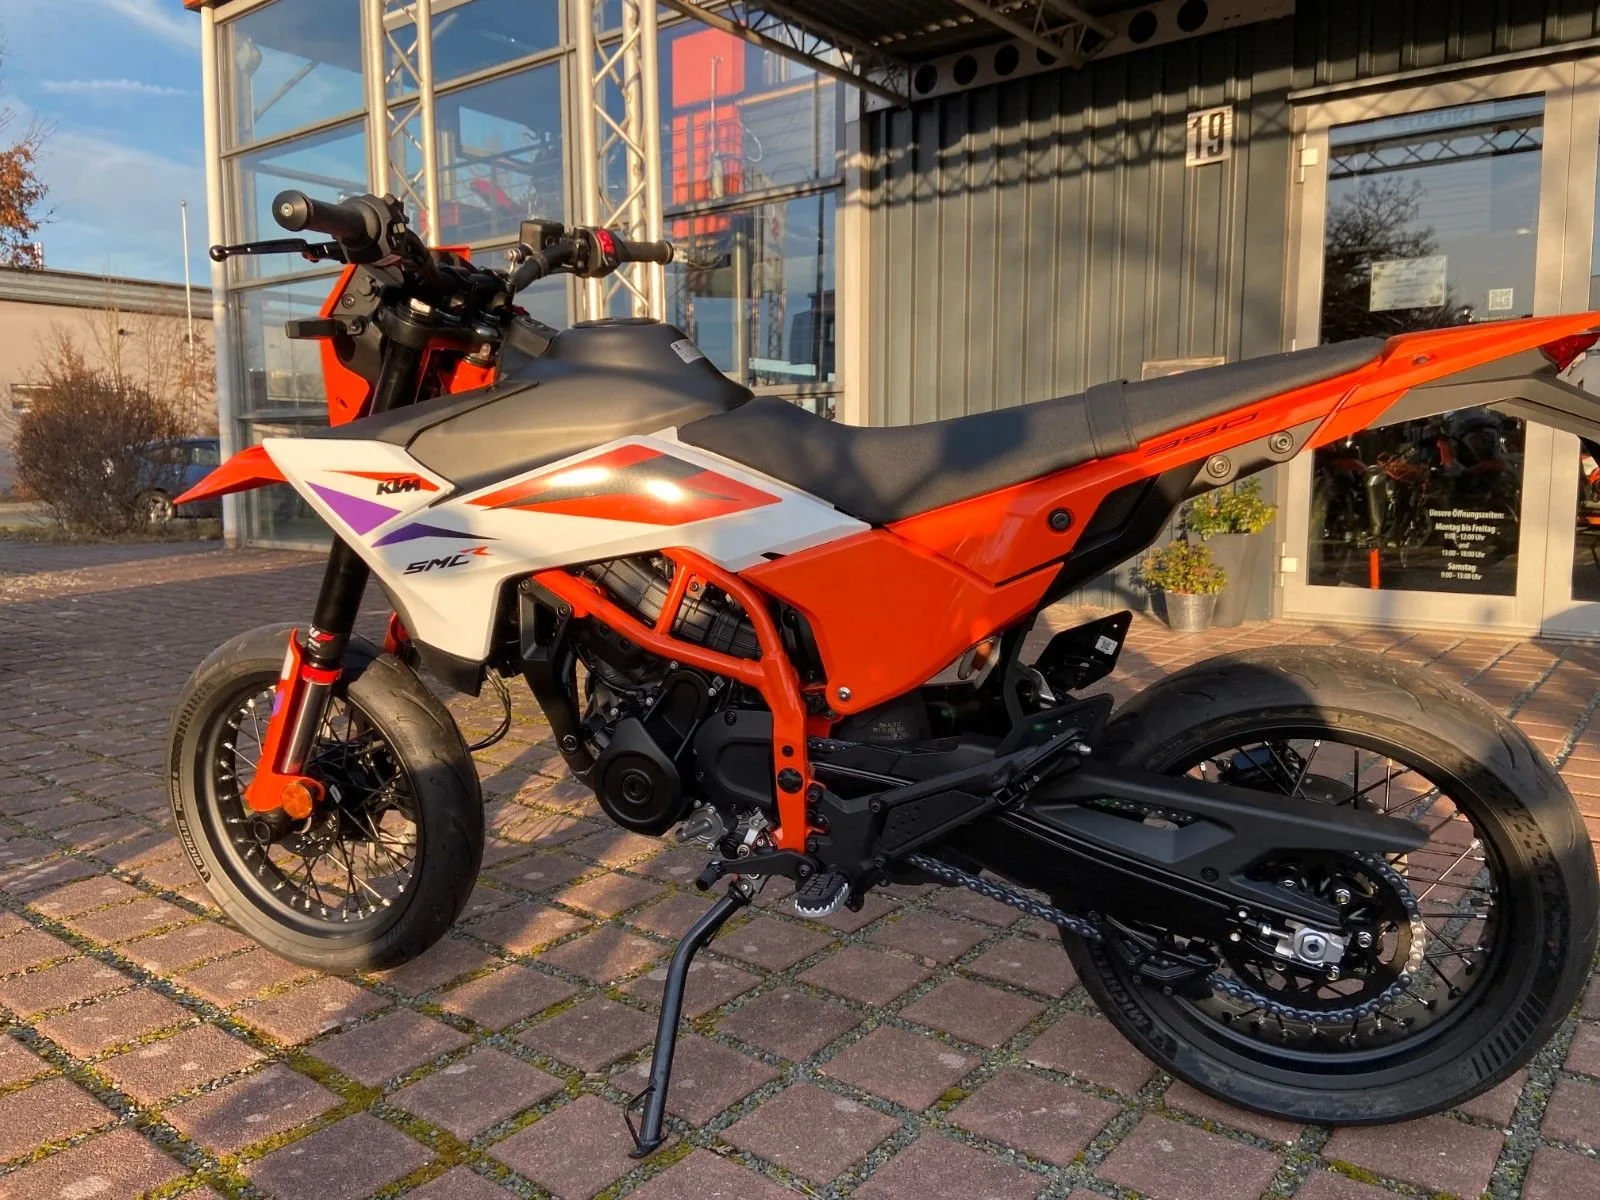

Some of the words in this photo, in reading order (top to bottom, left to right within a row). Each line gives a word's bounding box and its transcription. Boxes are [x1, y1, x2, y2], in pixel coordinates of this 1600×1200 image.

[1192, 112, 1225, 159] 19
[376, 475, 422, 495] KTM
[1429, 509, 1451, 517] Unsere
[1452, 508, 1504, 520] Öffnungszeiten:
[1435, 523, 1460, 532] Montag
[1461, 523, 1472, 532] bis
[1472, 524, 1496, 534] Freitag
[1460, 533, 1475, 541] 12:00
[403, 555, 470, 575] SMC
[1447, 562, 1478, 573] Samstag
[1471, 573, 1483, 581] Uhr
[179, 820, 203, 866] MICHELIN
